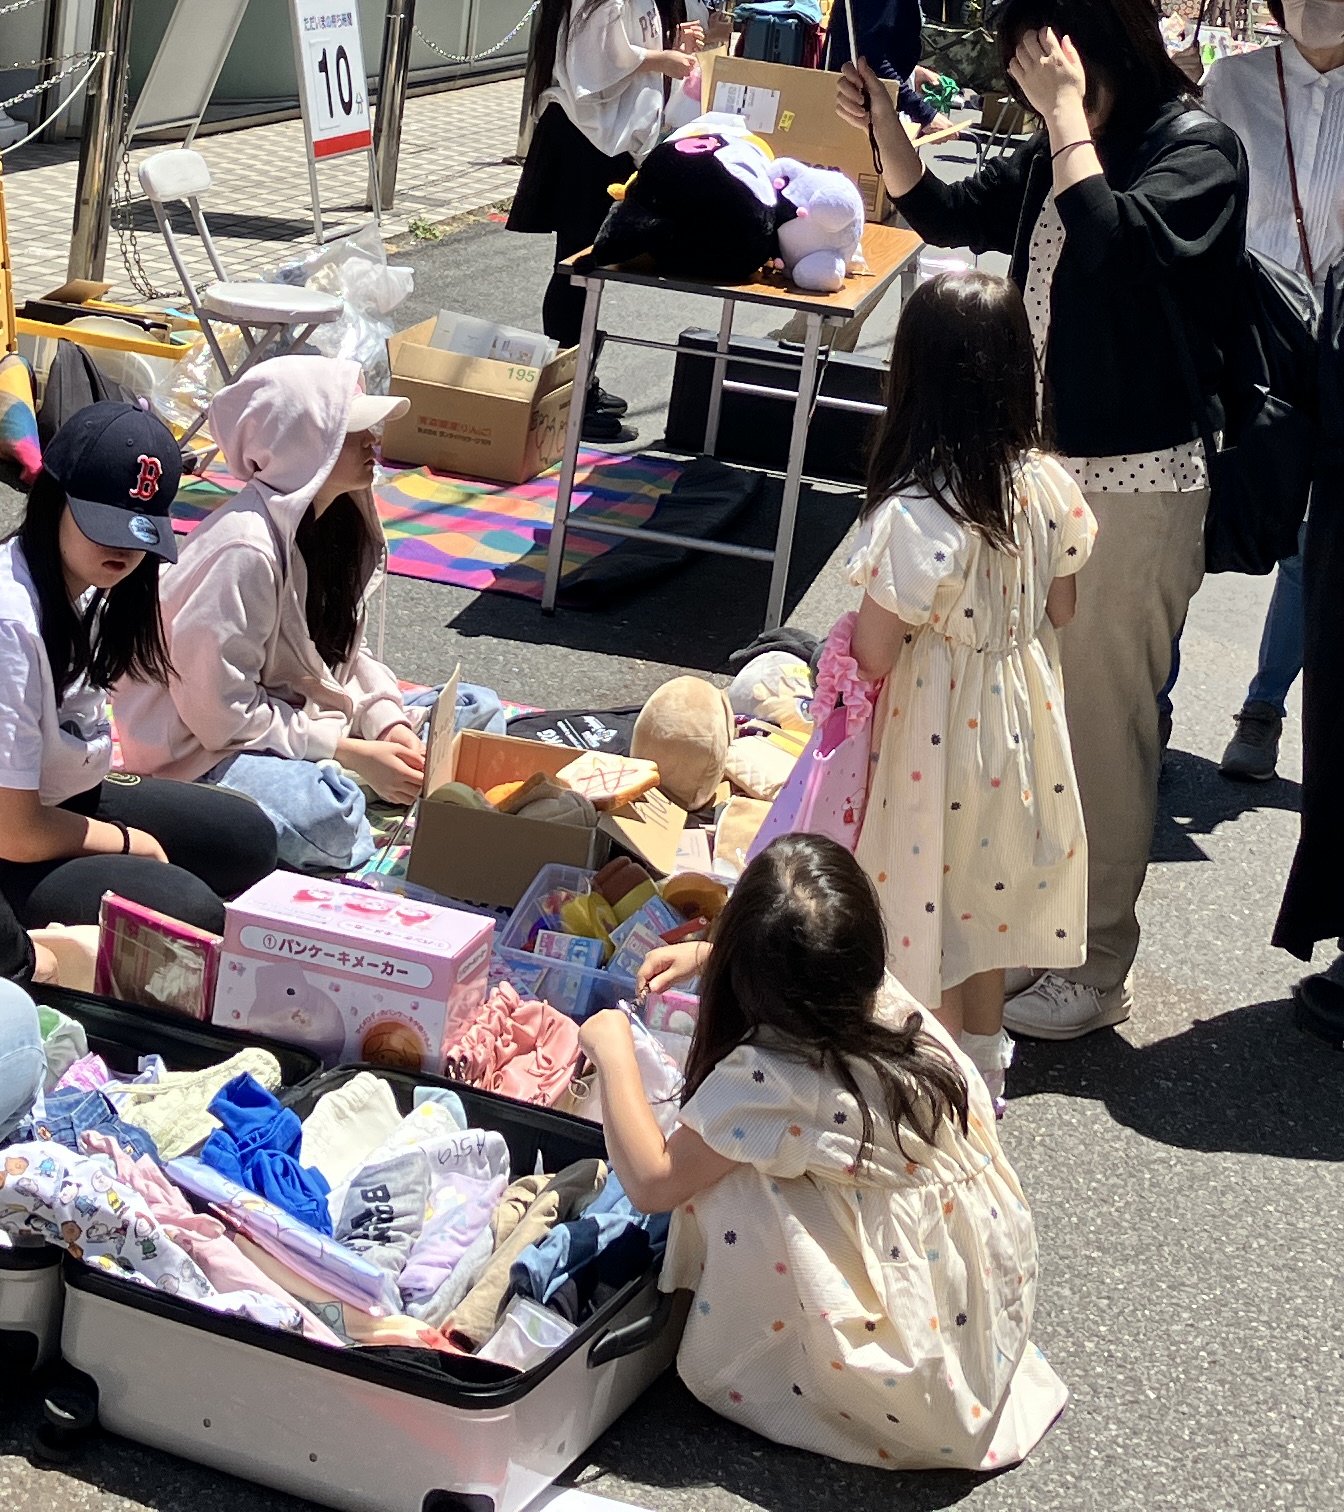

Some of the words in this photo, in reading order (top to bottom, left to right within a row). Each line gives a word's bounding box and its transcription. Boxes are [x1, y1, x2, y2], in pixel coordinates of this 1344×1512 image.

[317, 44, 354, 119] 10
[355, 91, 364, 115] 分
[507, 367, 537, 383] 195
[129, 454, 164, 501] B
